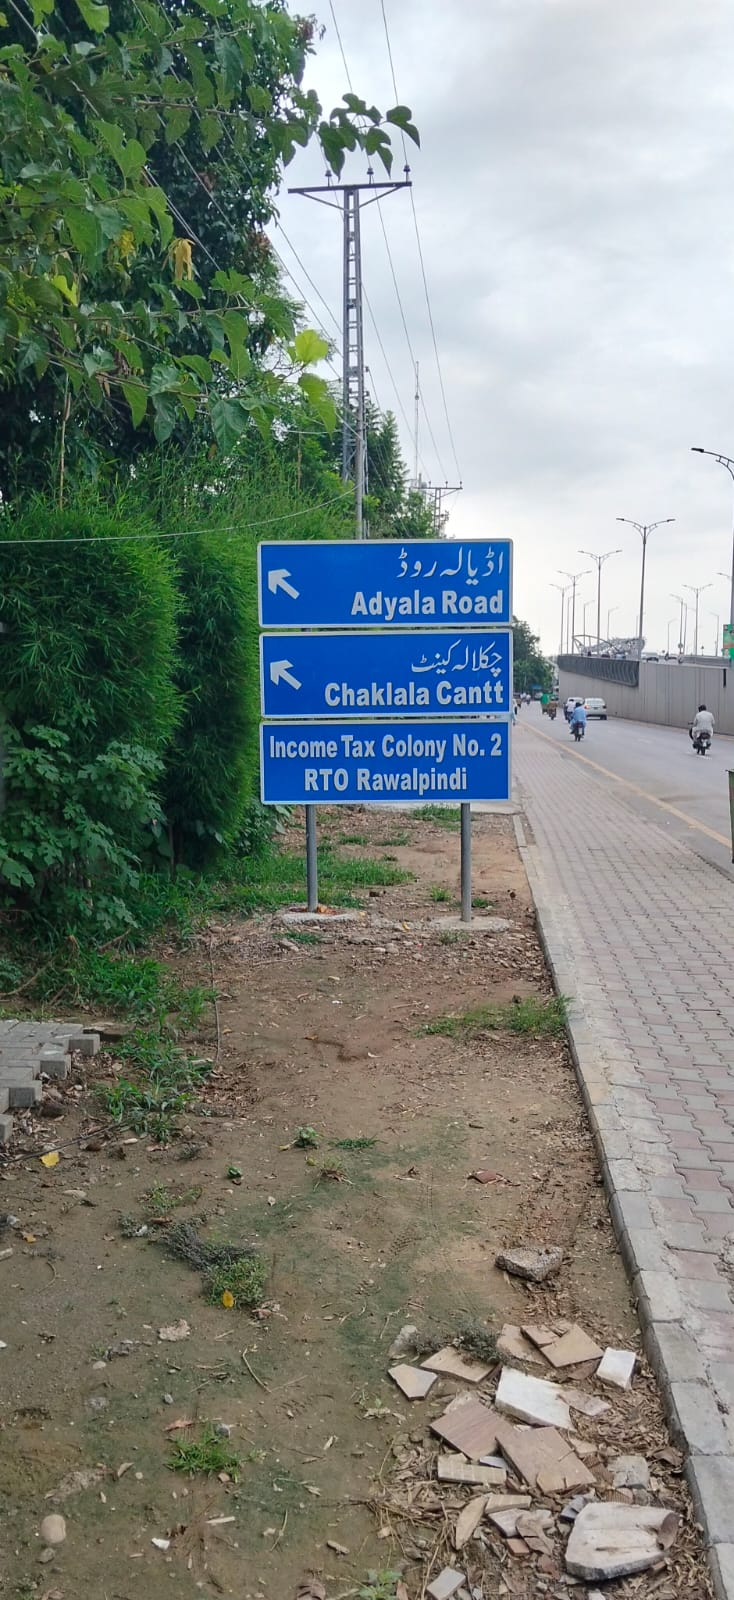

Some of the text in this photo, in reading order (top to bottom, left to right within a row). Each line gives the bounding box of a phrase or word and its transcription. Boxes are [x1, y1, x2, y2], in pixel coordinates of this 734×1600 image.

[396, 546, 504, 586] اڈیالہ روڈ
[351, 590, 503, 621] Adyala Road
[411, 638, 503, 678] چکلالہ کینٹ
[324, 680, 504, 706] Chaklala Cantt
[270, 733, 502, 763] Income Tax Colony No. 2
[304, 767, 467, 796] RTO Rawalpindi
